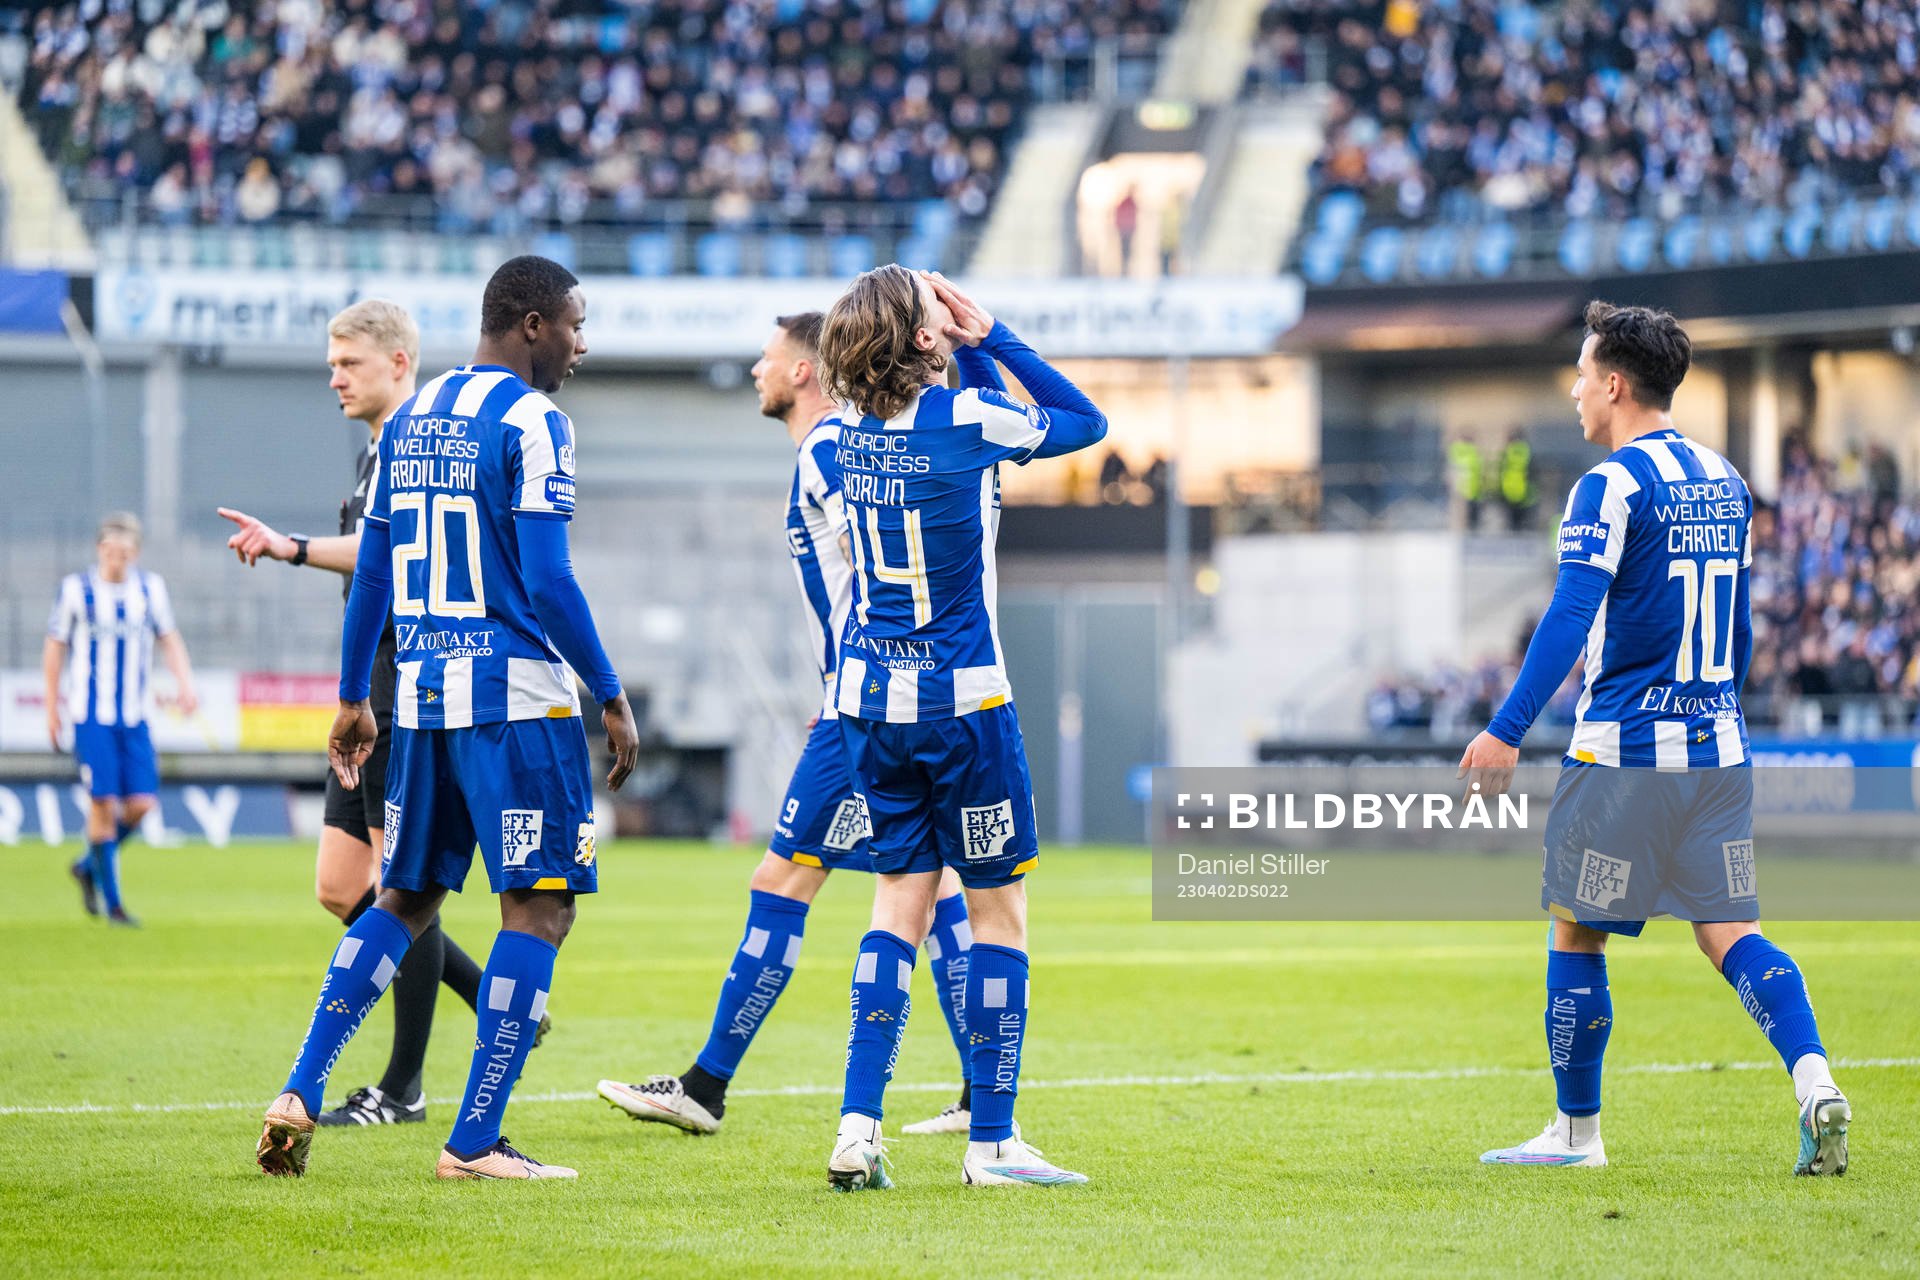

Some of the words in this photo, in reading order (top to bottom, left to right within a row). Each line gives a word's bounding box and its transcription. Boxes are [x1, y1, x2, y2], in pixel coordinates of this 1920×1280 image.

[407, 418, 468, 438] NORDIC
[393, 438, 480, 459] WELLNESS
[842, 429, 907, 452] NORDIC
[1668, 481, 1733, 502] NORDIC
[1654, 500, 1745, 523] WELLNESS
[1561, 522, 1607, 540] morris
[1667, 524, 1739, 553] CARNEIL
[390, 492, 487, 621] 20
[846, 503, 932, 630] 14
[1667, 558, 1738, 686] 10
[395, 624, 418, 652] El
[889, 659, 935, 671] INSTALCO
[1637, 686, 1672, 712] El
[503, 813, 533, 830] EFF
[783, 798, 800, 824] 9
[966, 806, 1003, 826] EFF
[503, 829, 537, 846] EKT
[967, 818, 1010, 841] EKT
[968, 839, 992, 855] IV
[1585, 853, 1622, 876] EFF
[1582, 867, 1624, 893] EKT
[1731, 876, 1750, 894] IV
[1580, 882, 1602, 902] IV
[729, 966, 784, 1040] SILFVERLOK
[1552, 996, 1577, 1072] SILFVERLOK
[993, 1012, 1020, 1093] SILFVERLOK
[464, 1017, 521, 1123] SILFVERLOK
